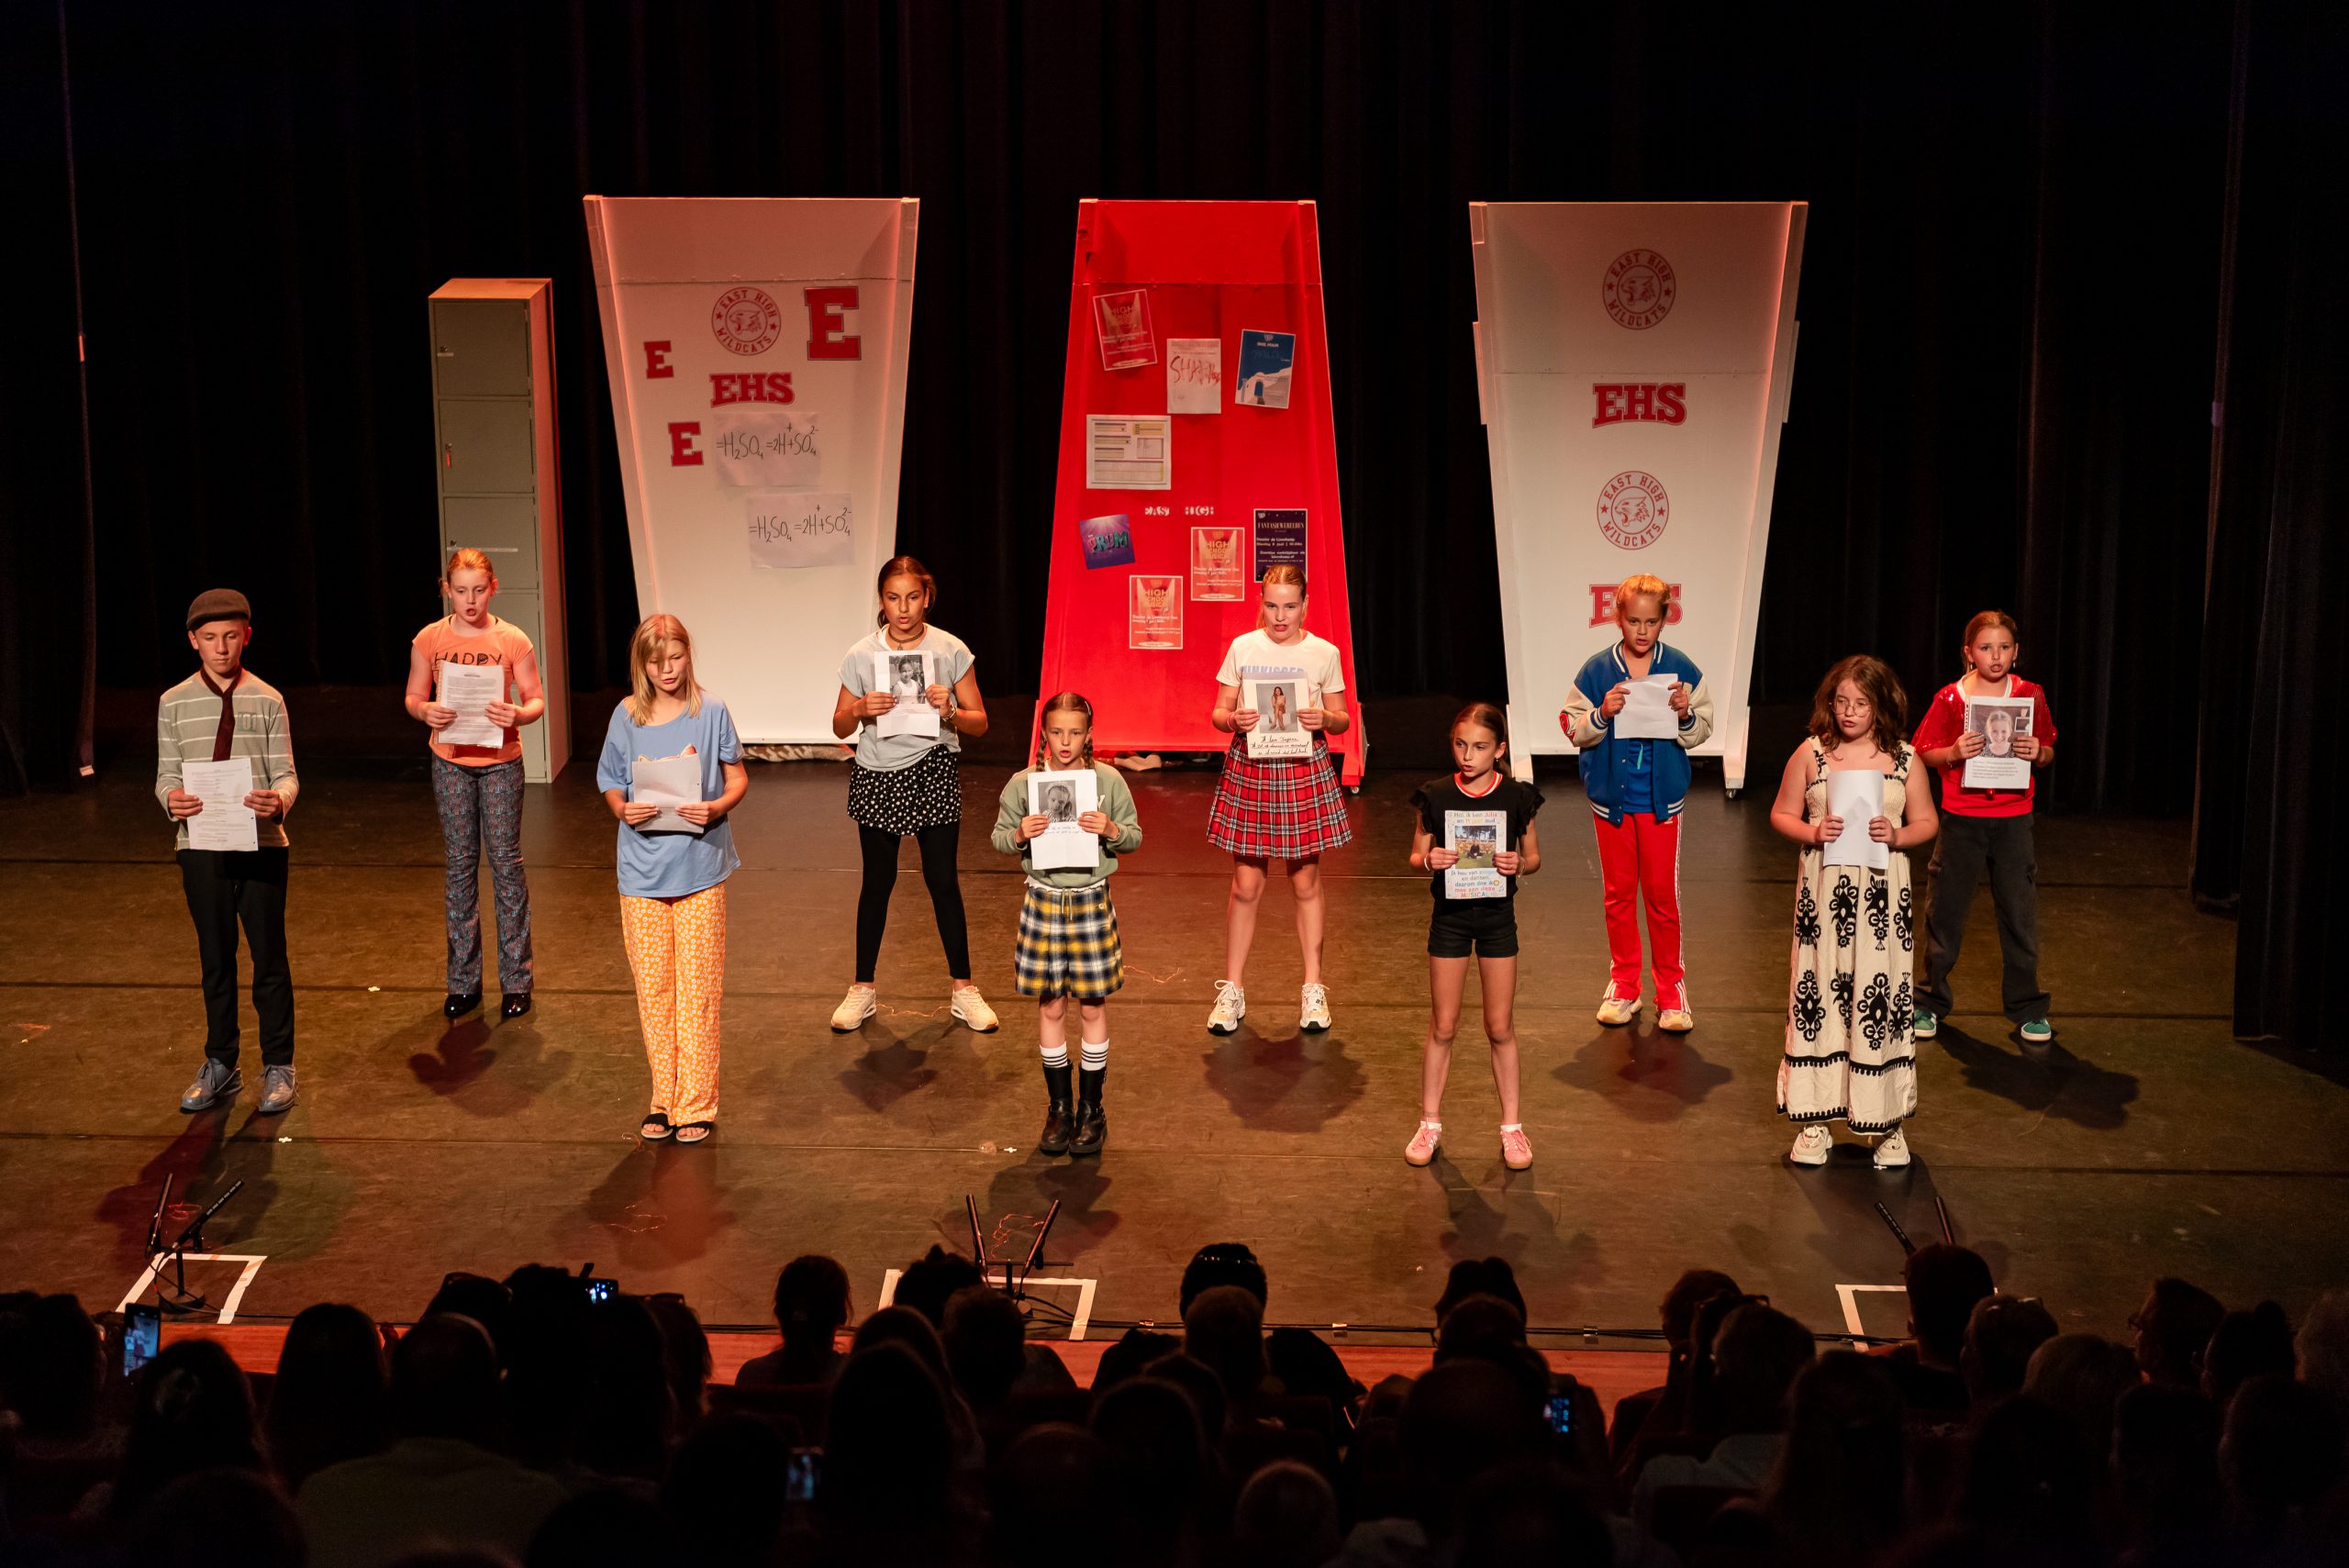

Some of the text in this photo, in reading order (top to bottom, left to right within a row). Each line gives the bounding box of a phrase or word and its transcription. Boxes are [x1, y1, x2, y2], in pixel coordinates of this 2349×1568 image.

[1610, 252, 1672, 283] EAST HIGH
[719, 290, 777, 317] EAST HIGH
[1608, 298, 1666, 327] WILDCATS
[804, 286, 862, 361] E
[717, 327, 772, 352] WILDCATS
[643, 339, 674, 379] E
[709, 372, 796, 408] EHS
[1592, 383, 1687, 428] EHS
[668, 421, 704, 467] E
[1603, 473, 1664, 502] EAST HIGH
[1205, 540, 1230, 549] HIGH
[1603, 521, 1661, 547] WILDCATS
[1589, 584, 1683, 628] ES
